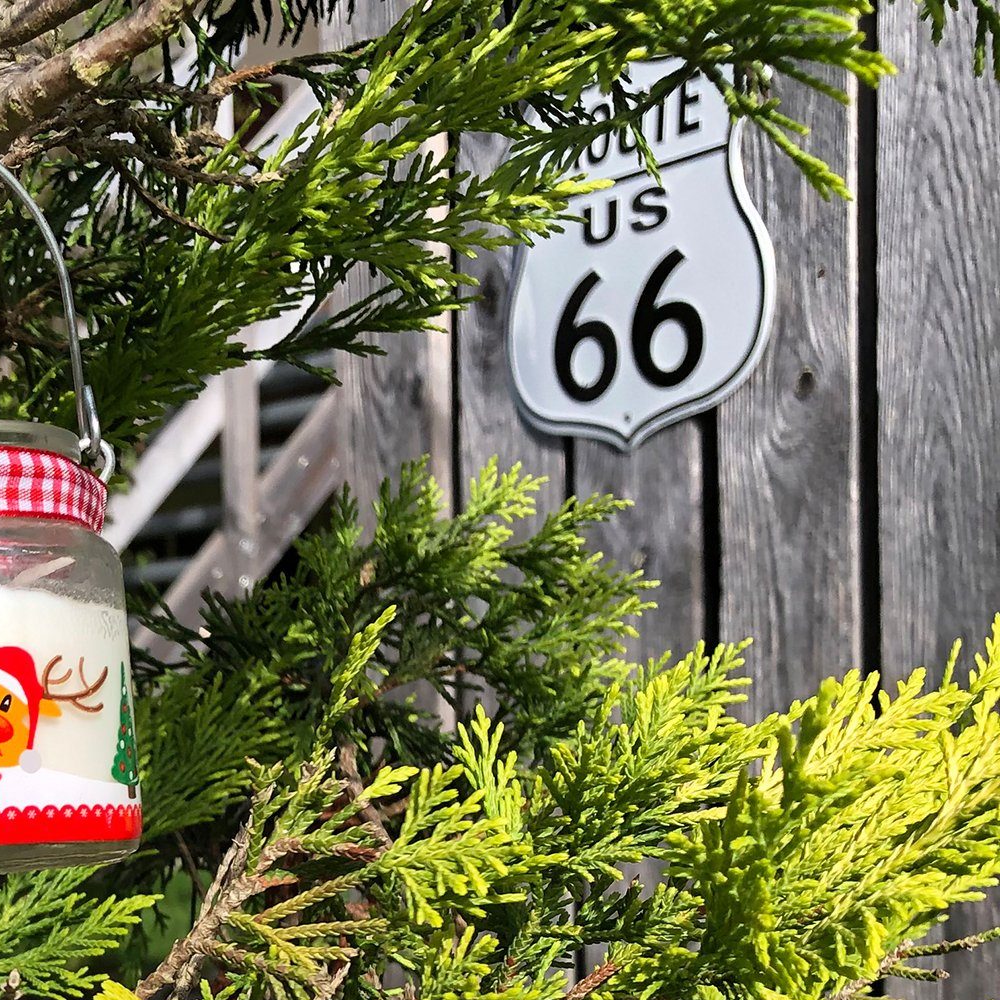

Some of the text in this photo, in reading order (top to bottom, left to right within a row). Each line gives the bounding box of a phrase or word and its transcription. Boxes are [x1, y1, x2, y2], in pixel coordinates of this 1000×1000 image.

[557, 69, 701, 170] OUTE
[583, 186, 668, 245] US
[554, 248, 704, 403] 66
